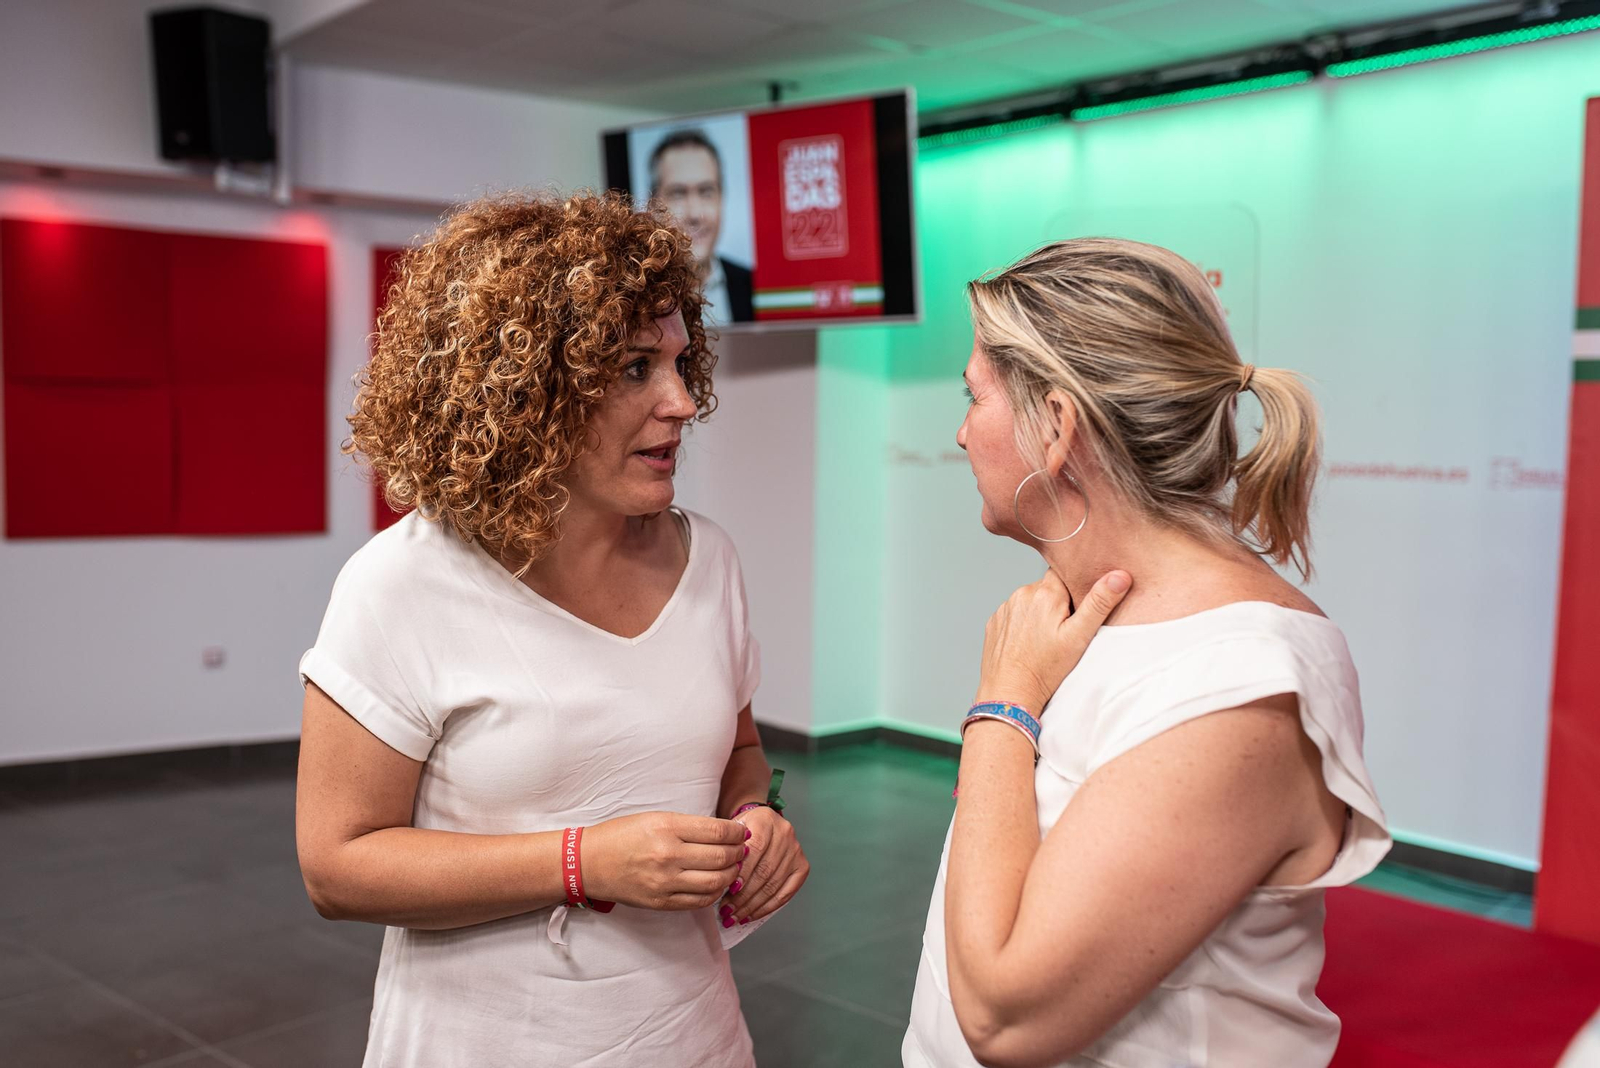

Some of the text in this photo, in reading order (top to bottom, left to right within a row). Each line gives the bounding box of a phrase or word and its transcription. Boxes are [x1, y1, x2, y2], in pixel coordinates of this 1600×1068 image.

[788, 142, 838, 162] JUAN
[786, 182, 841, 212] DAS
[569, 875, 579, 897] JUAN
